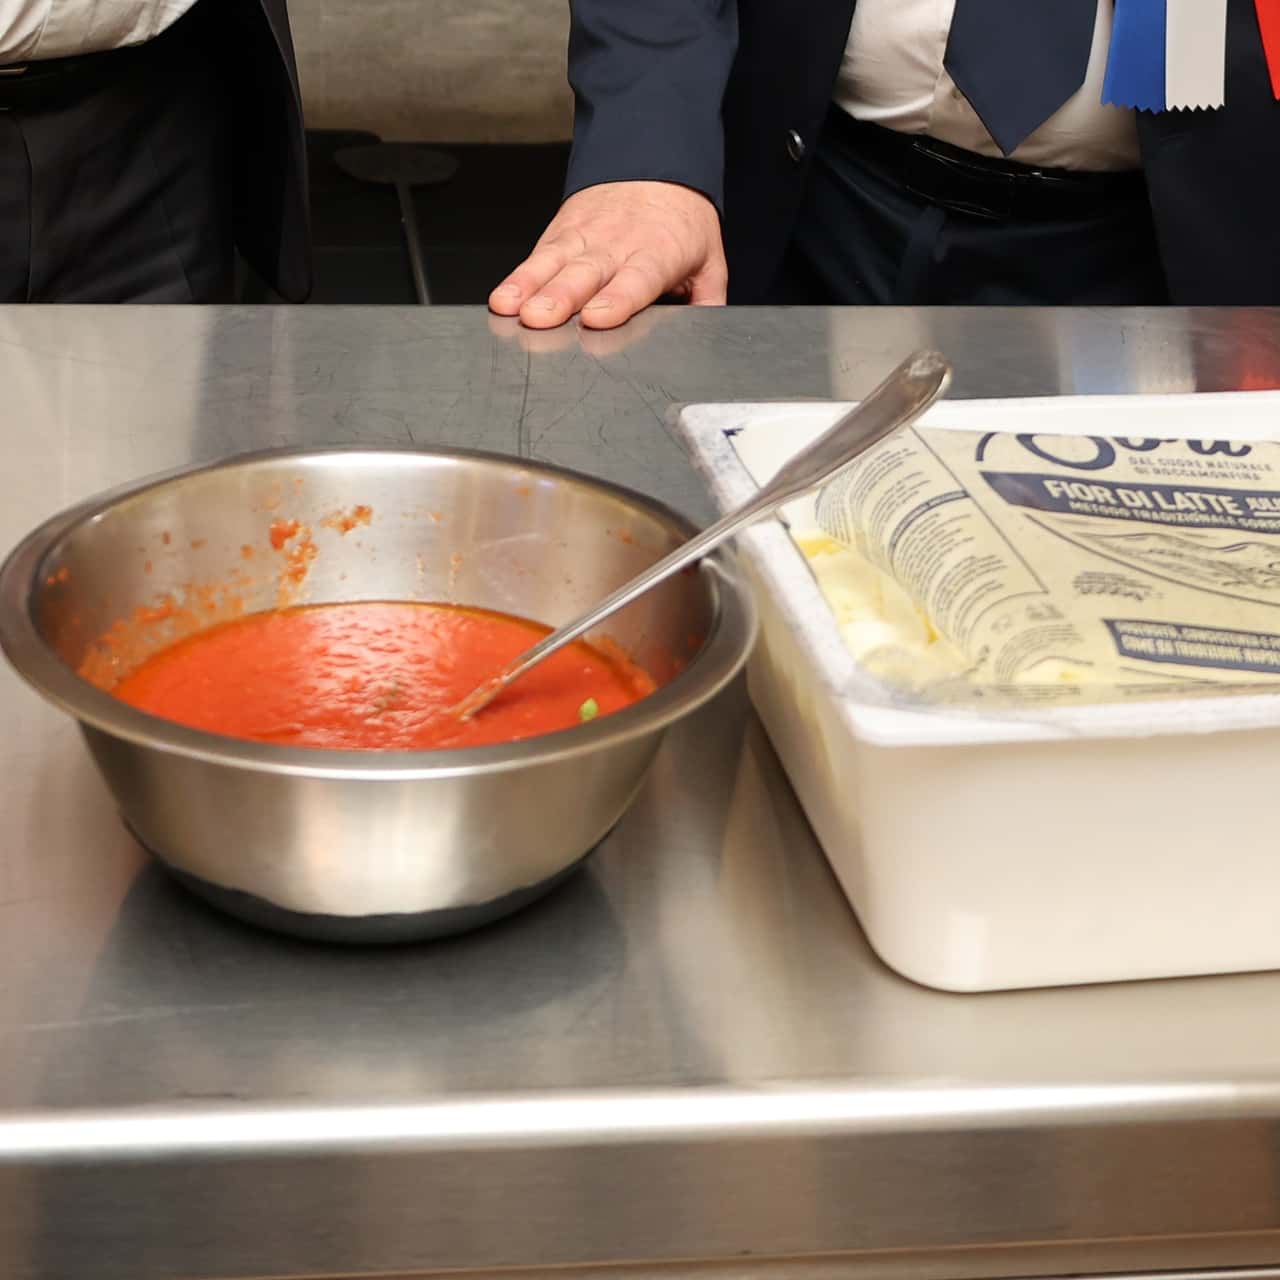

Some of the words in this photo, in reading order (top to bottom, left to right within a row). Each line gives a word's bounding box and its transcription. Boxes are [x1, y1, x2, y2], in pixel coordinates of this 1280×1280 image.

[1043, 479, 1116, 505] FIOR
[1116, 488, 1154, 508] DI
[1152, 490, 1244, 516] LATTE
